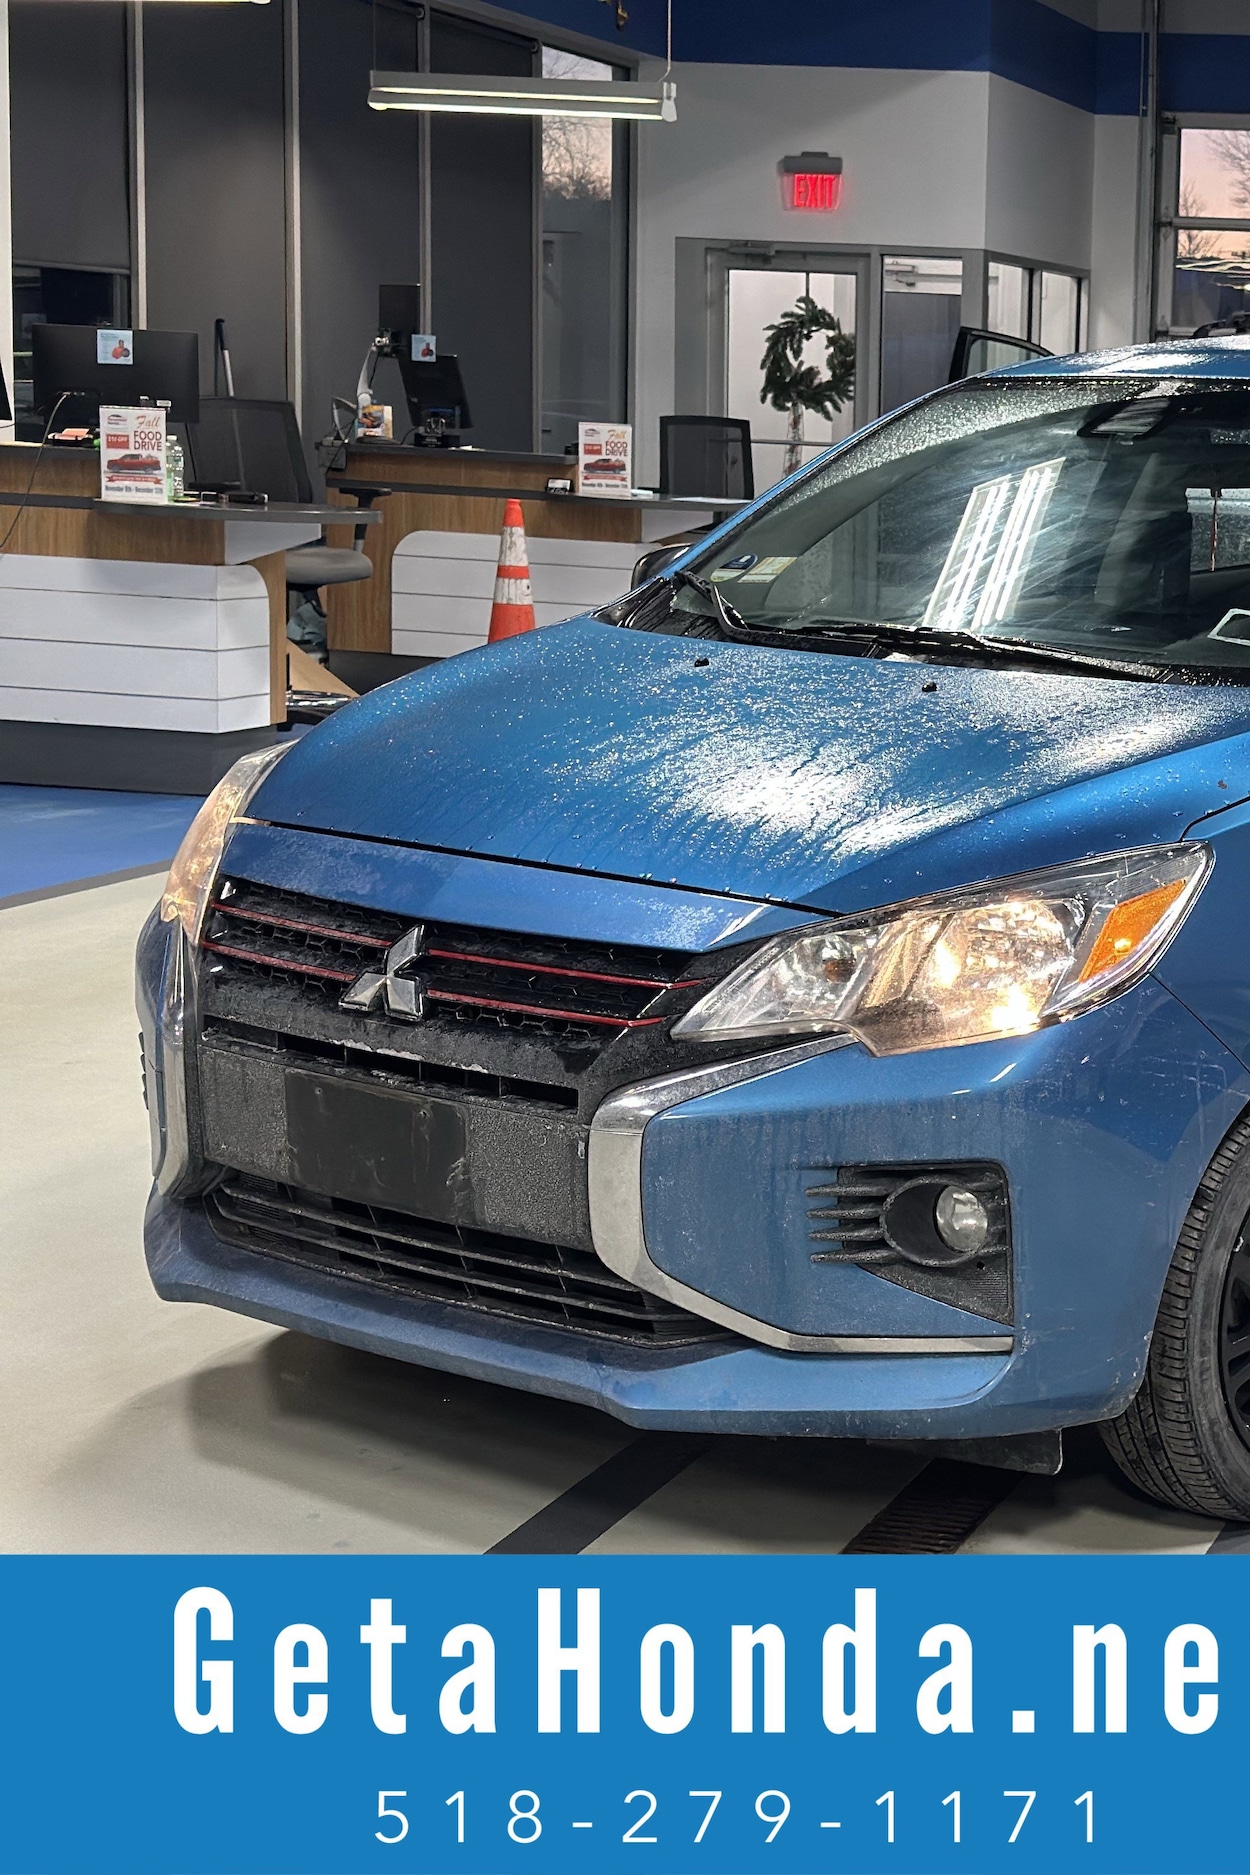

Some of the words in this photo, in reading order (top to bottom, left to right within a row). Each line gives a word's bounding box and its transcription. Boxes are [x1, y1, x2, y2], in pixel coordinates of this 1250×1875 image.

[794, 174, 835, 208] EXIT
[135, 415, 160, 428] Fall
[133, 430, 162, 441] FOOD
[133, 441, 162, 451] DRIVE
[605, 441, 628, 449] FOOD
[605, 448, 628, 456] DRIVE
